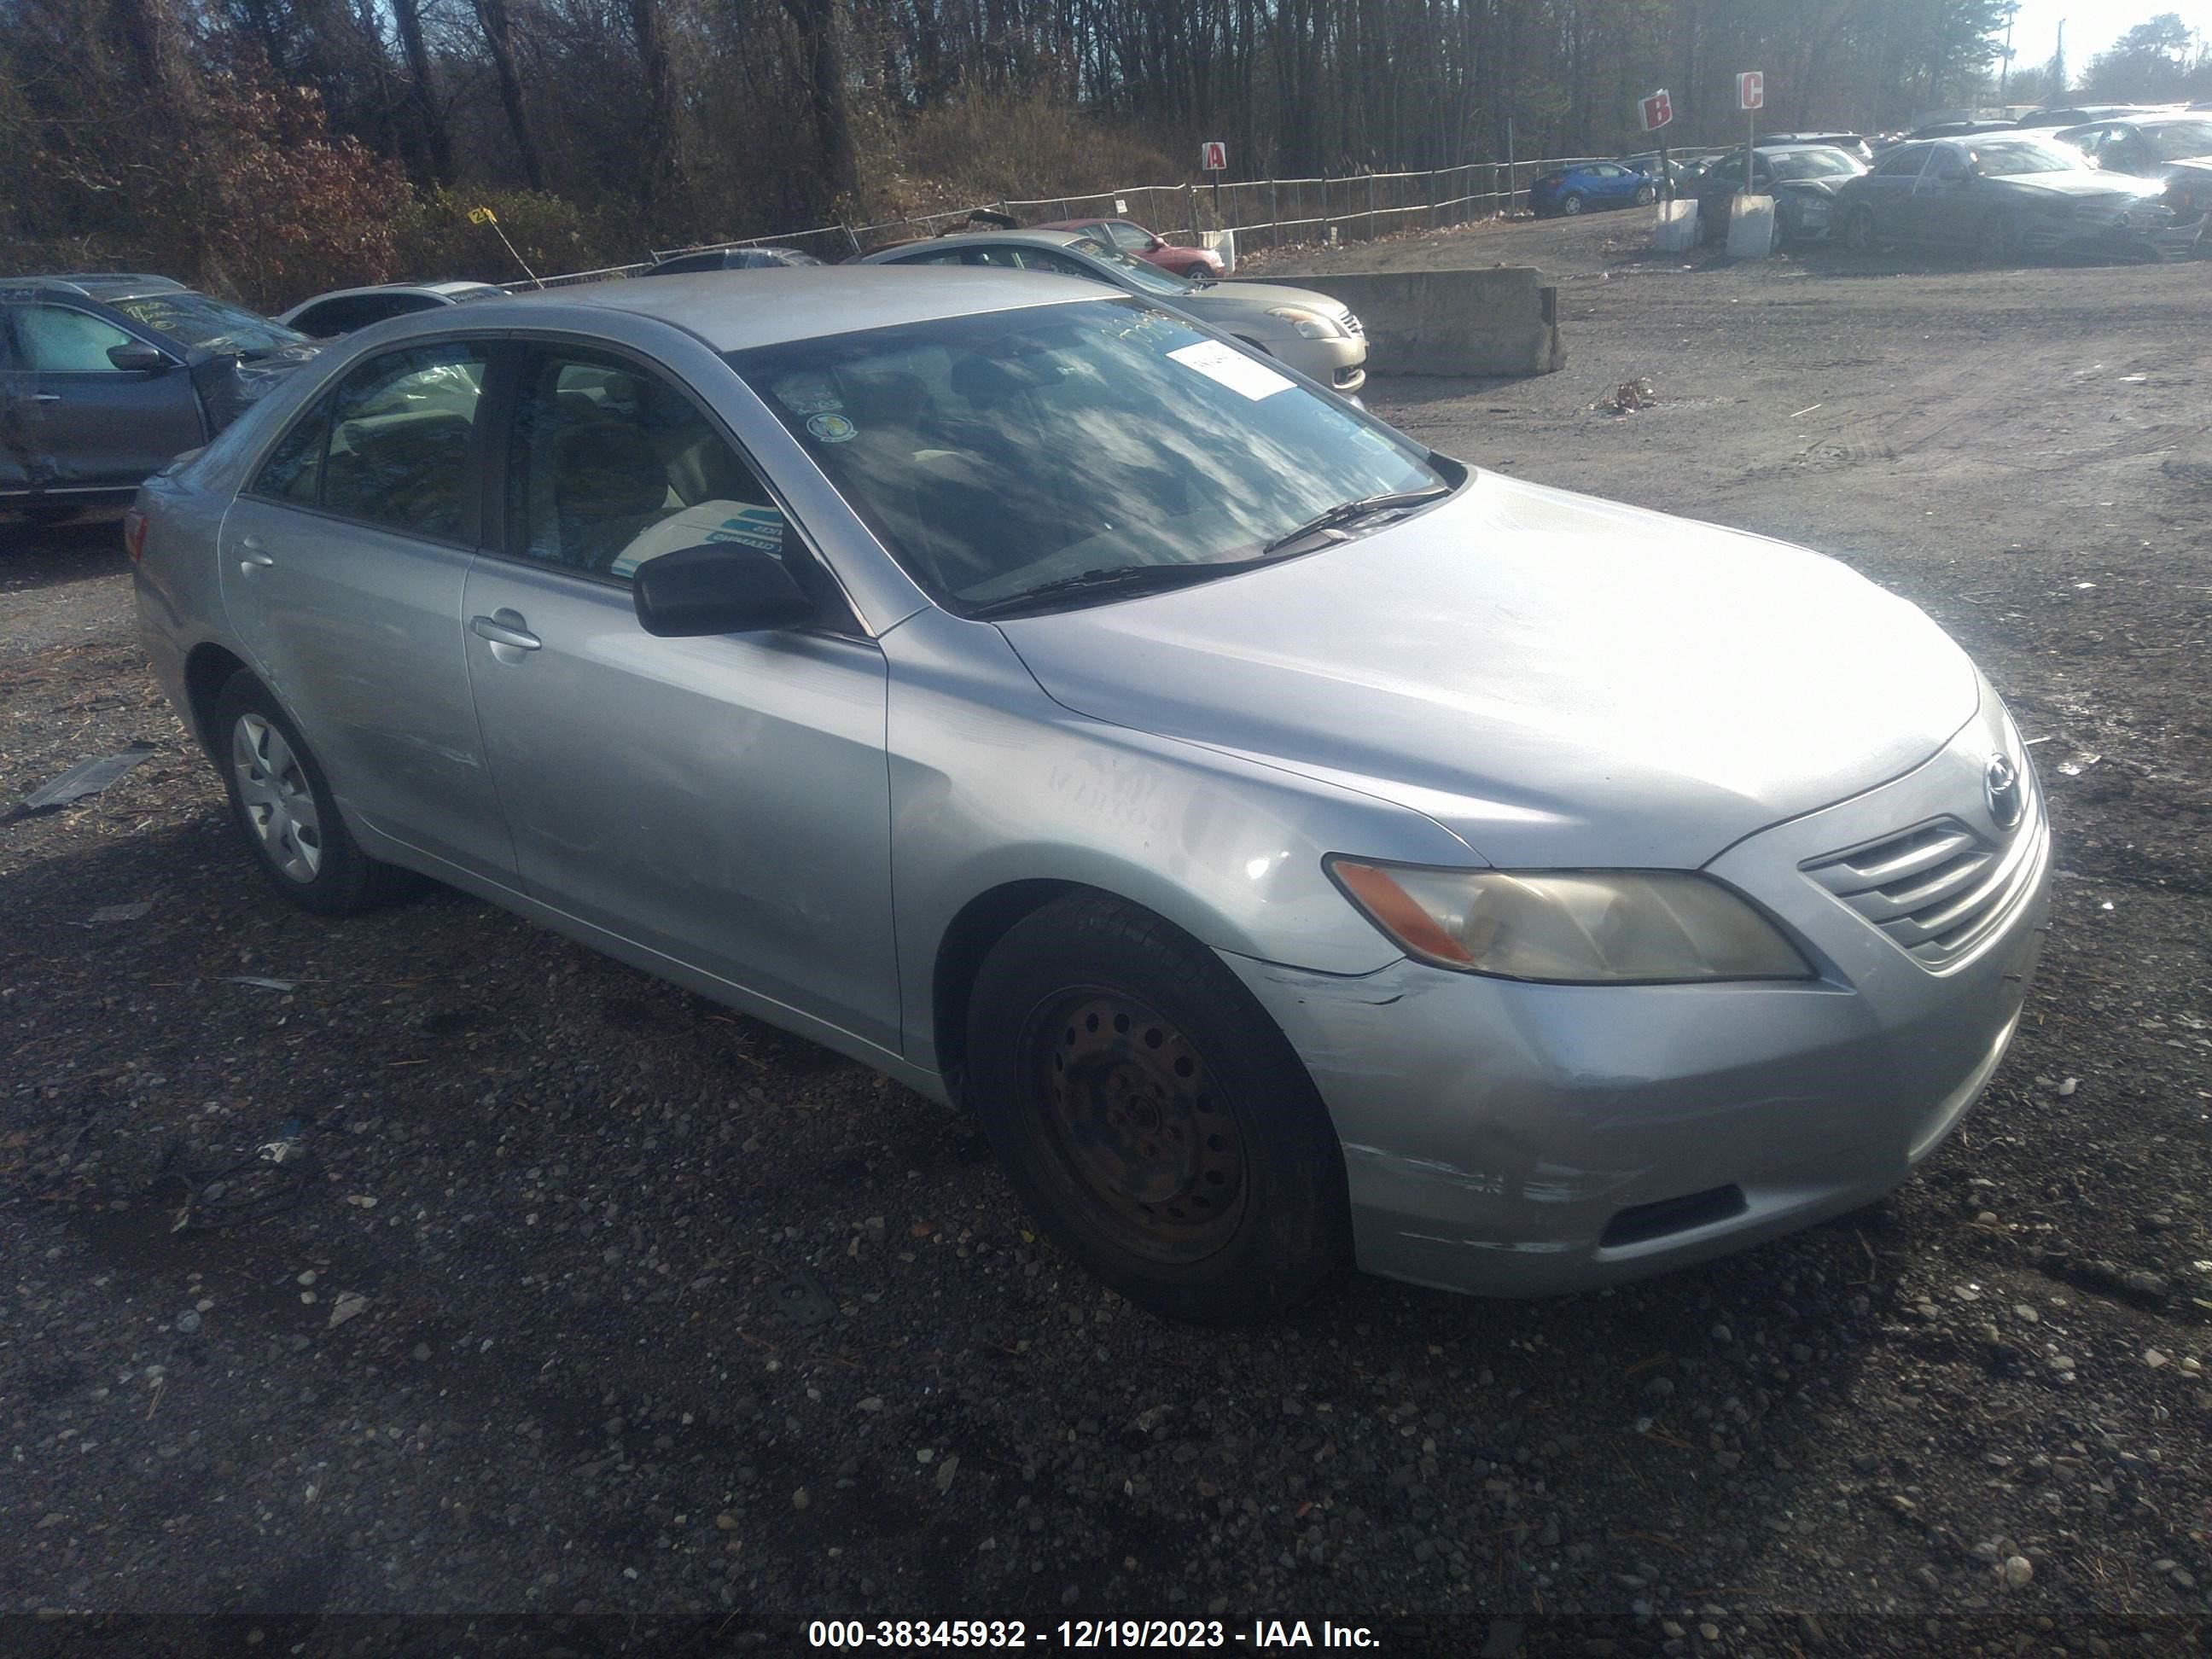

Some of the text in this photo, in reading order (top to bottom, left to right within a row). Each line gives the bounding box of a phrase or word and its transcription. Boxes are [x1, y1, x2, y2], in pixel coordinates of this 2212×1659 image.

[1743, 73, 1763, 108] C
[1644, 94, 1673, 129] B
[1207, 143, 1226, 168] A
